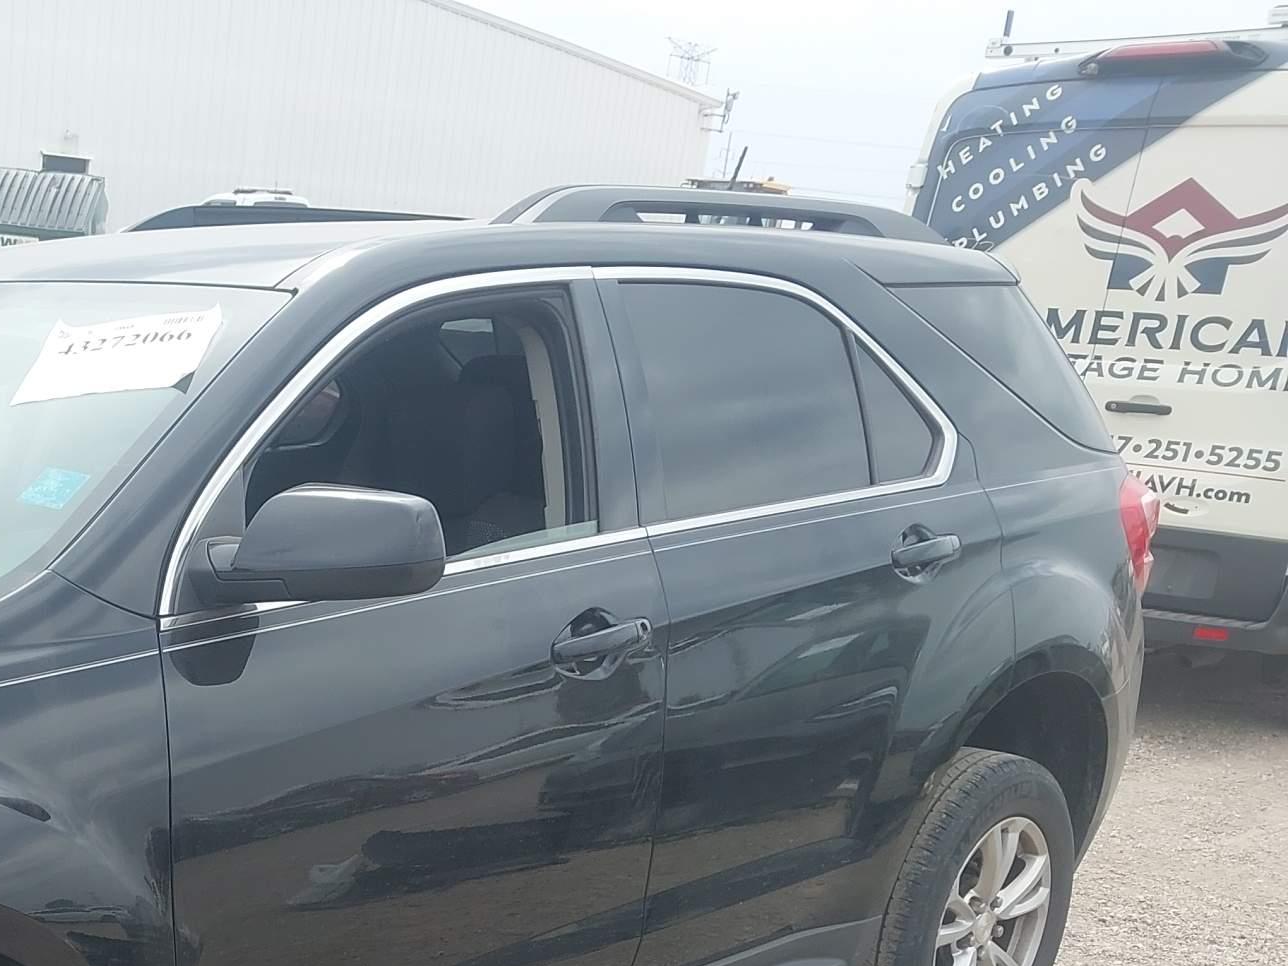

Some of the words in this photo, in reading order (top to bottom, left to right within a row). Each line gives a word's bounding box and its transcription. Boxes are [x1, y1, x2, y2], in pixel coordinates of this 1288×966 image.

[937, 84, 1062, 180] HEATING
[952, 116, 1076, 213] COOLING
[58, 329, 192, 356] 43272066
[1046, 307, 1288, 357] MERICA
[1176, 360, 1288, 392] HOM
[1110, 434, 1283, 473] 7•251•5255
